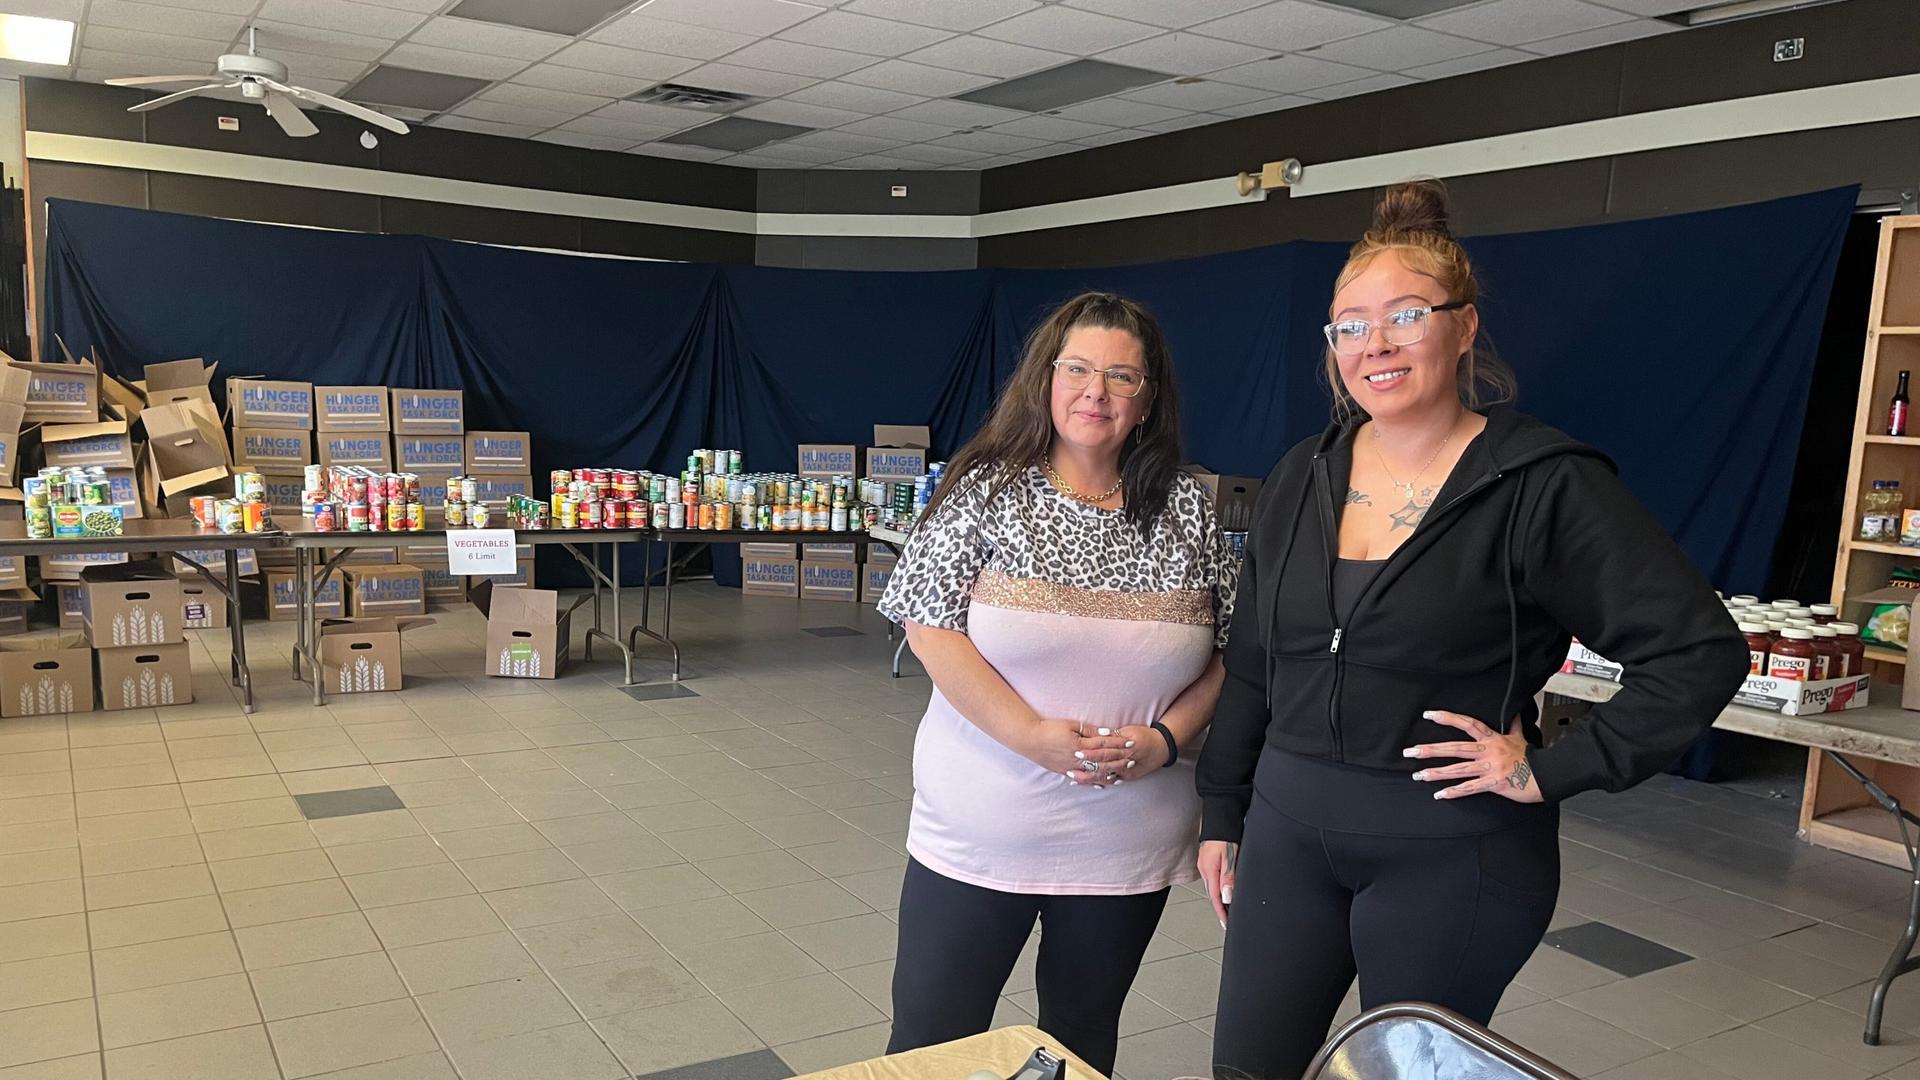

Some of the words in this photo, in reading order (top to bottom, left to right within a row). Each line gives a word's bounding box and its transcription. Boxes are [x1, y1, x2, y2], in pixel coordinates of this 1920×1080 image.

[243, 387, 308, 403] HUNGER
[326, 394, 379, 405] HUNGER
[244, 401, 270, 411] TASK
[274, 402, 308, 412] FORCE
[400, 396, 459, 409] HUNGER
[327, 405, 351, 413] TASK
[354, 405, 379, 413] FORCE
[402, 409, 425, 418] TASK
[428, 410, 459, 418] FORCE
[245, 435, 301, 449] HUNGER
[328, 440, 382, 451] HUNGER
[403, 441, 460, 453] HUNGER
[473, 439, 522, 450] HUNGER
[245, 447, 270, 456] TASK
[272, 448, 302, 457] FORCE
[801, 451, 852, 463] HUNGER
[404, 454, 427, 463] TASK
[430, 454, 461, 463] FORCE
[871, 454, 921, 466] HUNGER
[802, 462, 823, 471] TASK
[825, 463, 852, 471] FORCE
[872, 466, 892, 474] TASK
[894, 467, 921, 476] FORCE
[454, 540, 509, 548] VEGETABLES
[475, 552, 496, 560] Limit
[746, 562, 795, 575] HUNGER
[804, 566, 854, 580] HUNGER
[746, 574, 768, 582] TASK
[769, 575, 795, 583] FORCE
[805, 579, 824, 587] TASK
[826, 579, 854, 588] FORCE
[360, 577, 420, 592] HUNGER
[1772, 656, 1805, 670] Prego
[1801, 685, 1834, 706] Prego
